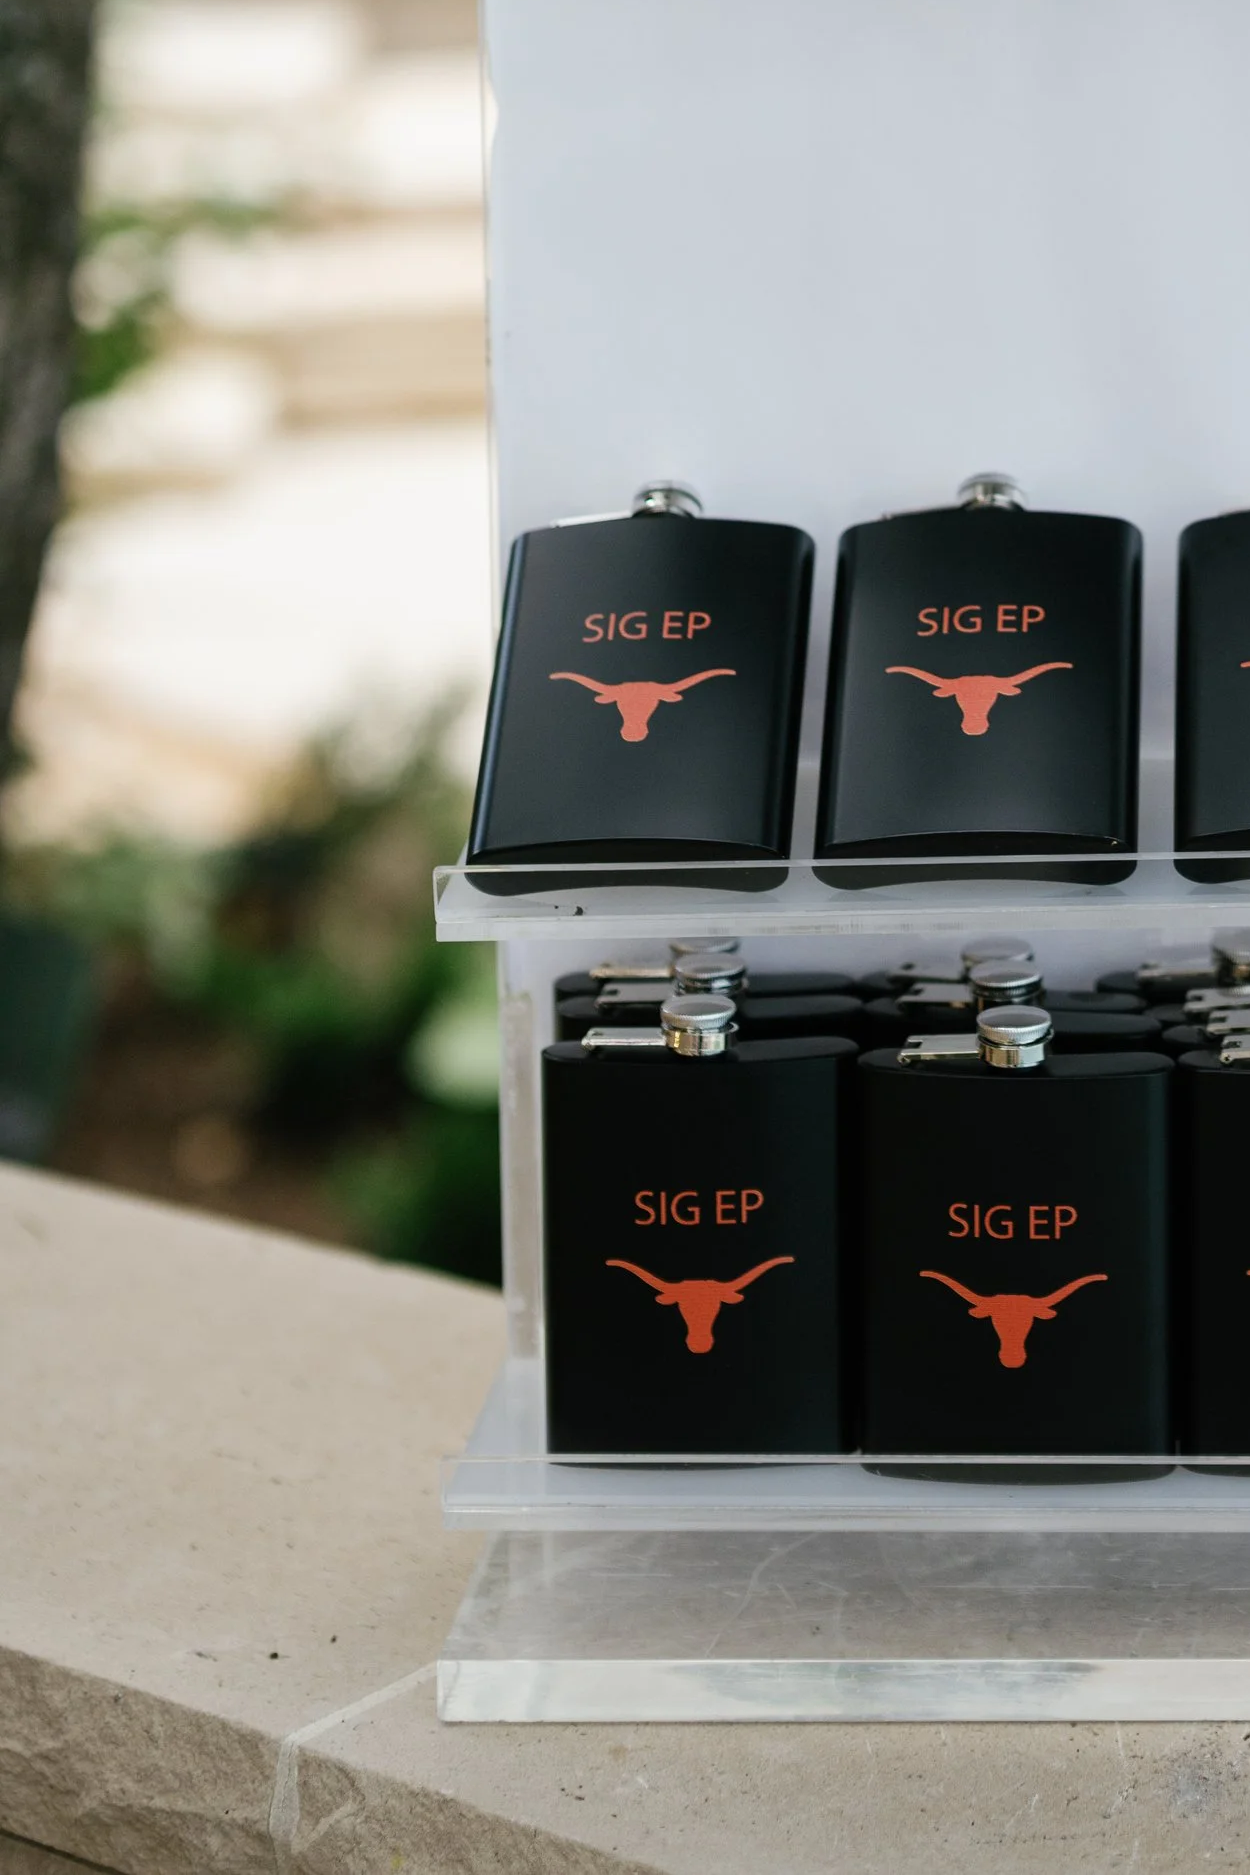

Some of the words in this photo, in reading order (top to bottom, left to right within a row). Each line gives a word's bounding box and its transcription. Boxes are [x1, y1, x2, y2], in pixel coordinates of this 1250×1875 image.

[584, 611, 649, 643] SIG
[662, 610, 712, 640] EP
[918, 604, 983, 637] SIG
[996, 604, 1046, 633] EP
[634, 1189, 702, 1227] SIG
[714, 1188, 765, 1226] EP
[948, 1201, 1015, 1240] SIG
[1028, 1204, 1078, 1241] EP
